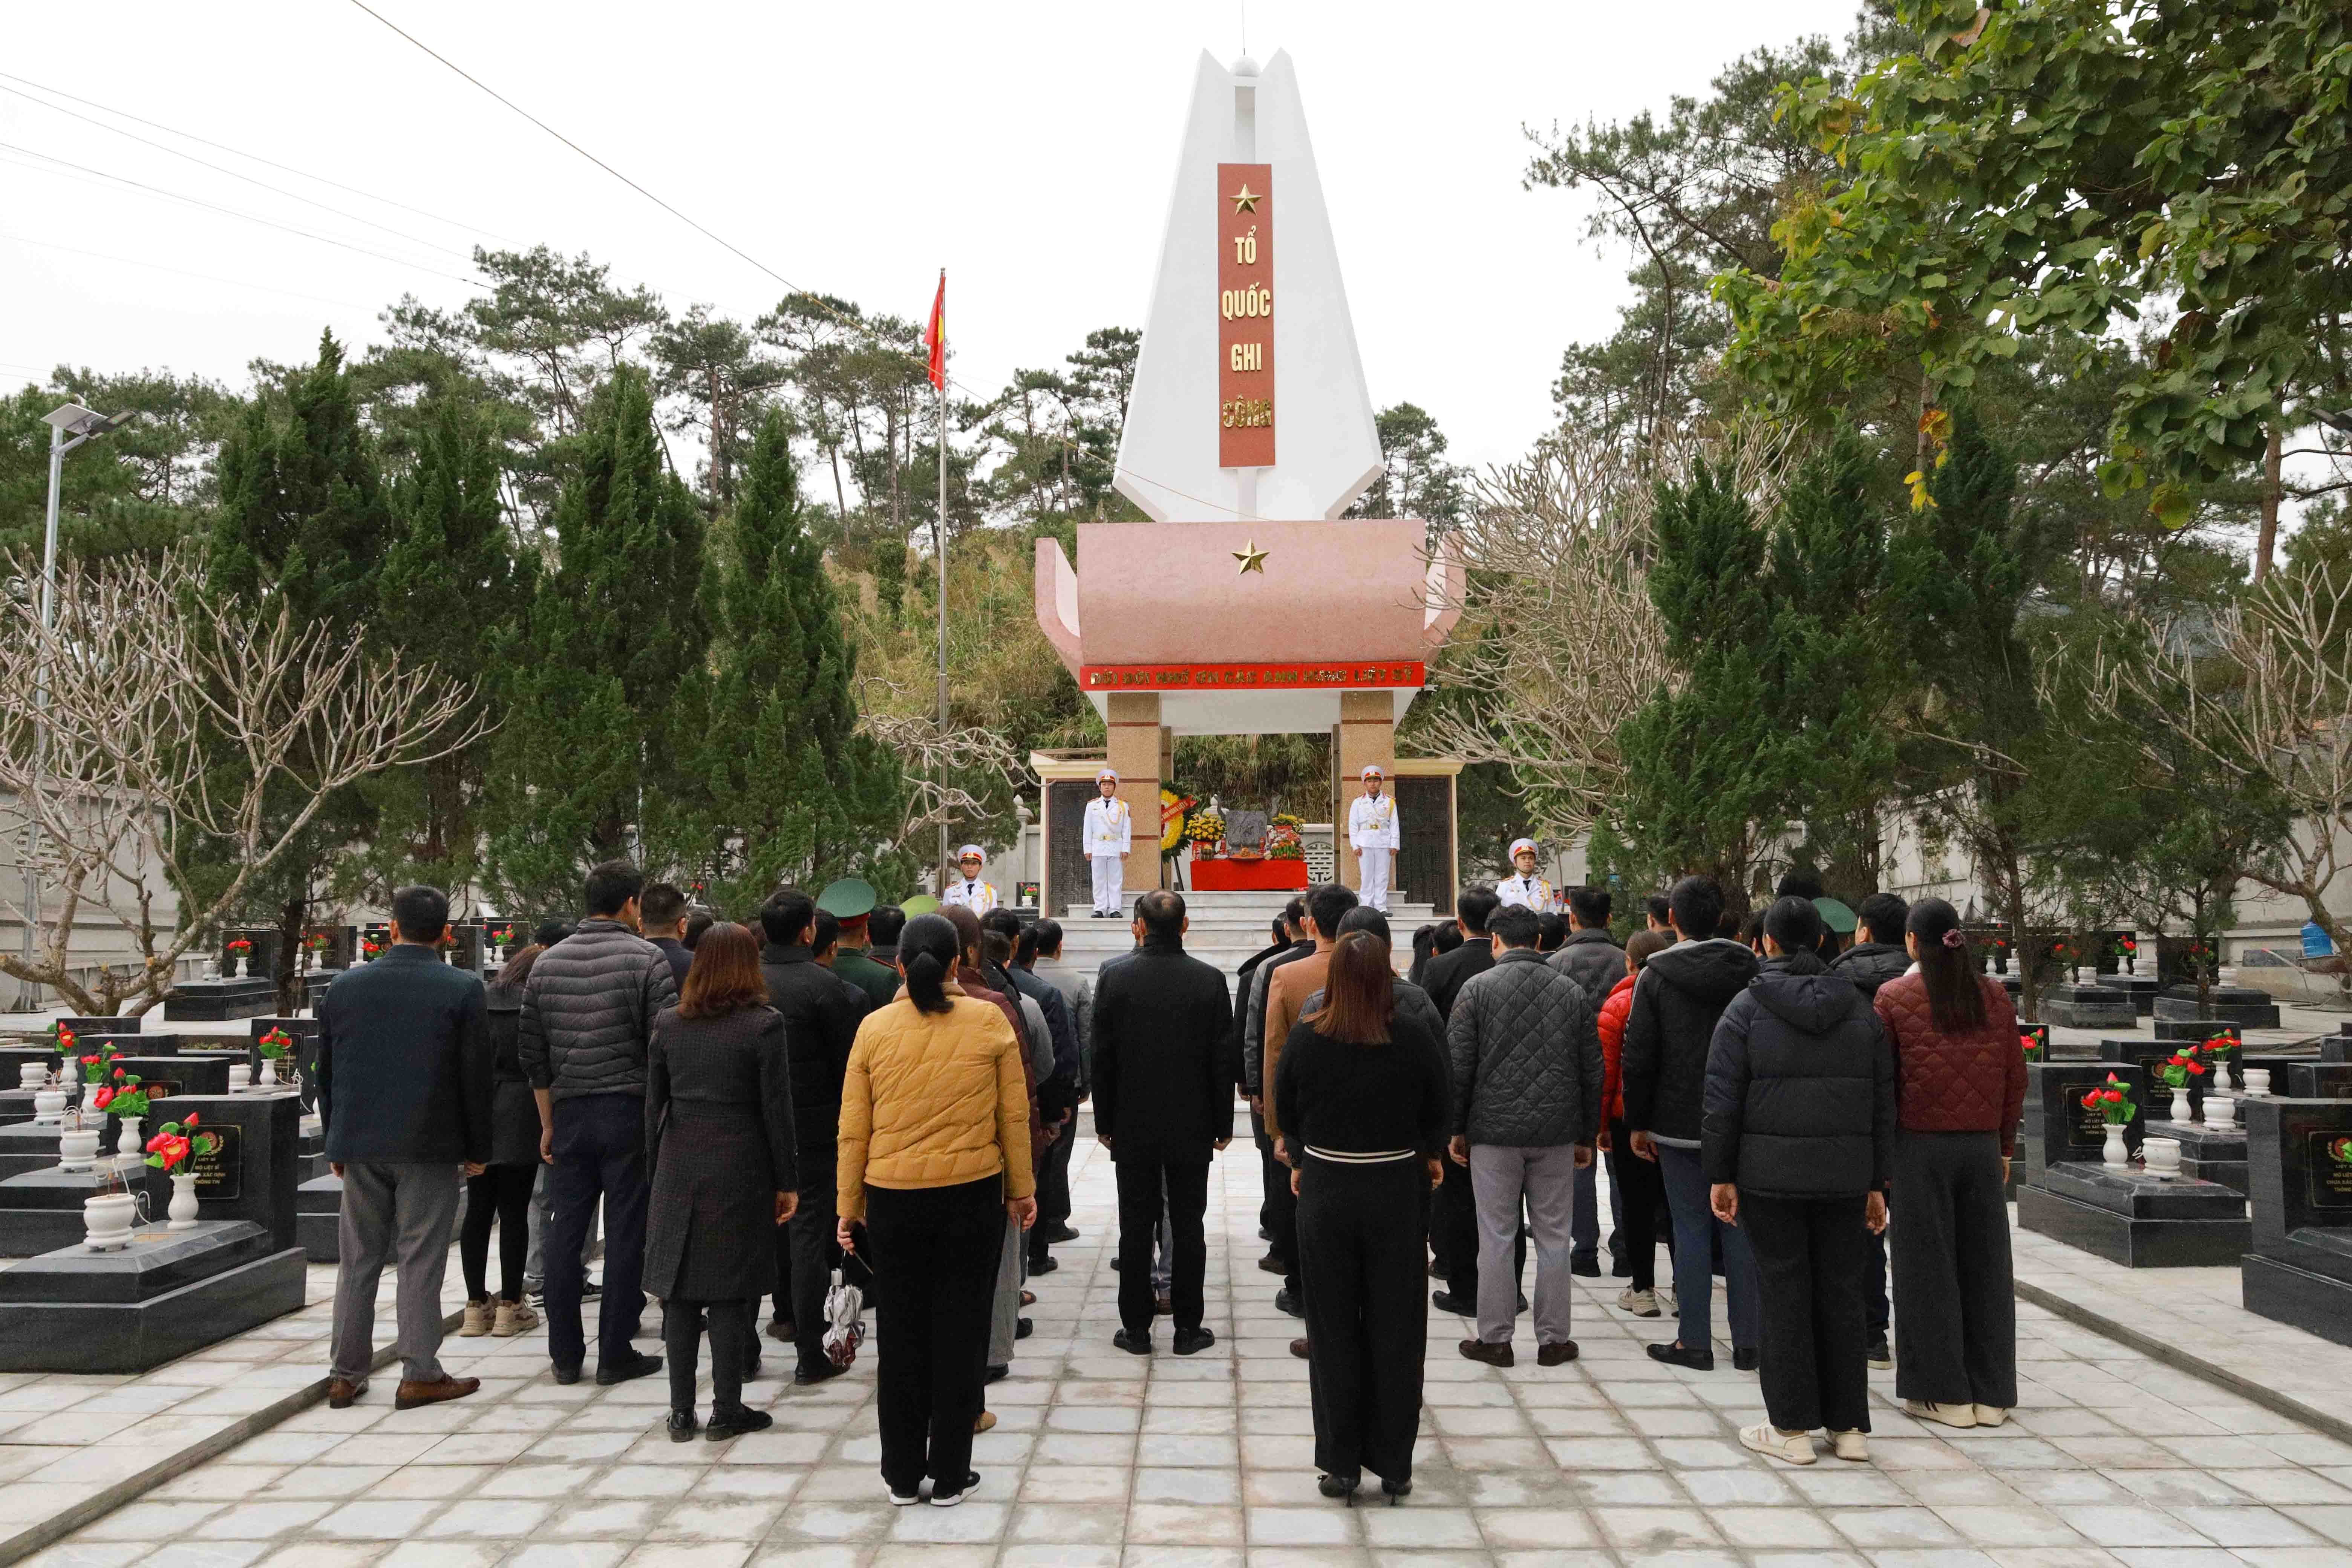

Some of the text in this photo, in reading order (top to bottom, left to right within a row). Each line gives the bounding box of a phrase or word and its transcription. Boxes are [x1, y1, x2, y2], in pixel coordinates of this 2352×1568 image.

[1234, 225, 1257, 265] TỔ
[1222, 282, 1271, 321] QUỐC
[1231, 343, 1262, 372] GHI
[1222, 392, 1271, 427] CÔNG
[1264, 670, 1297, 683] ANH
